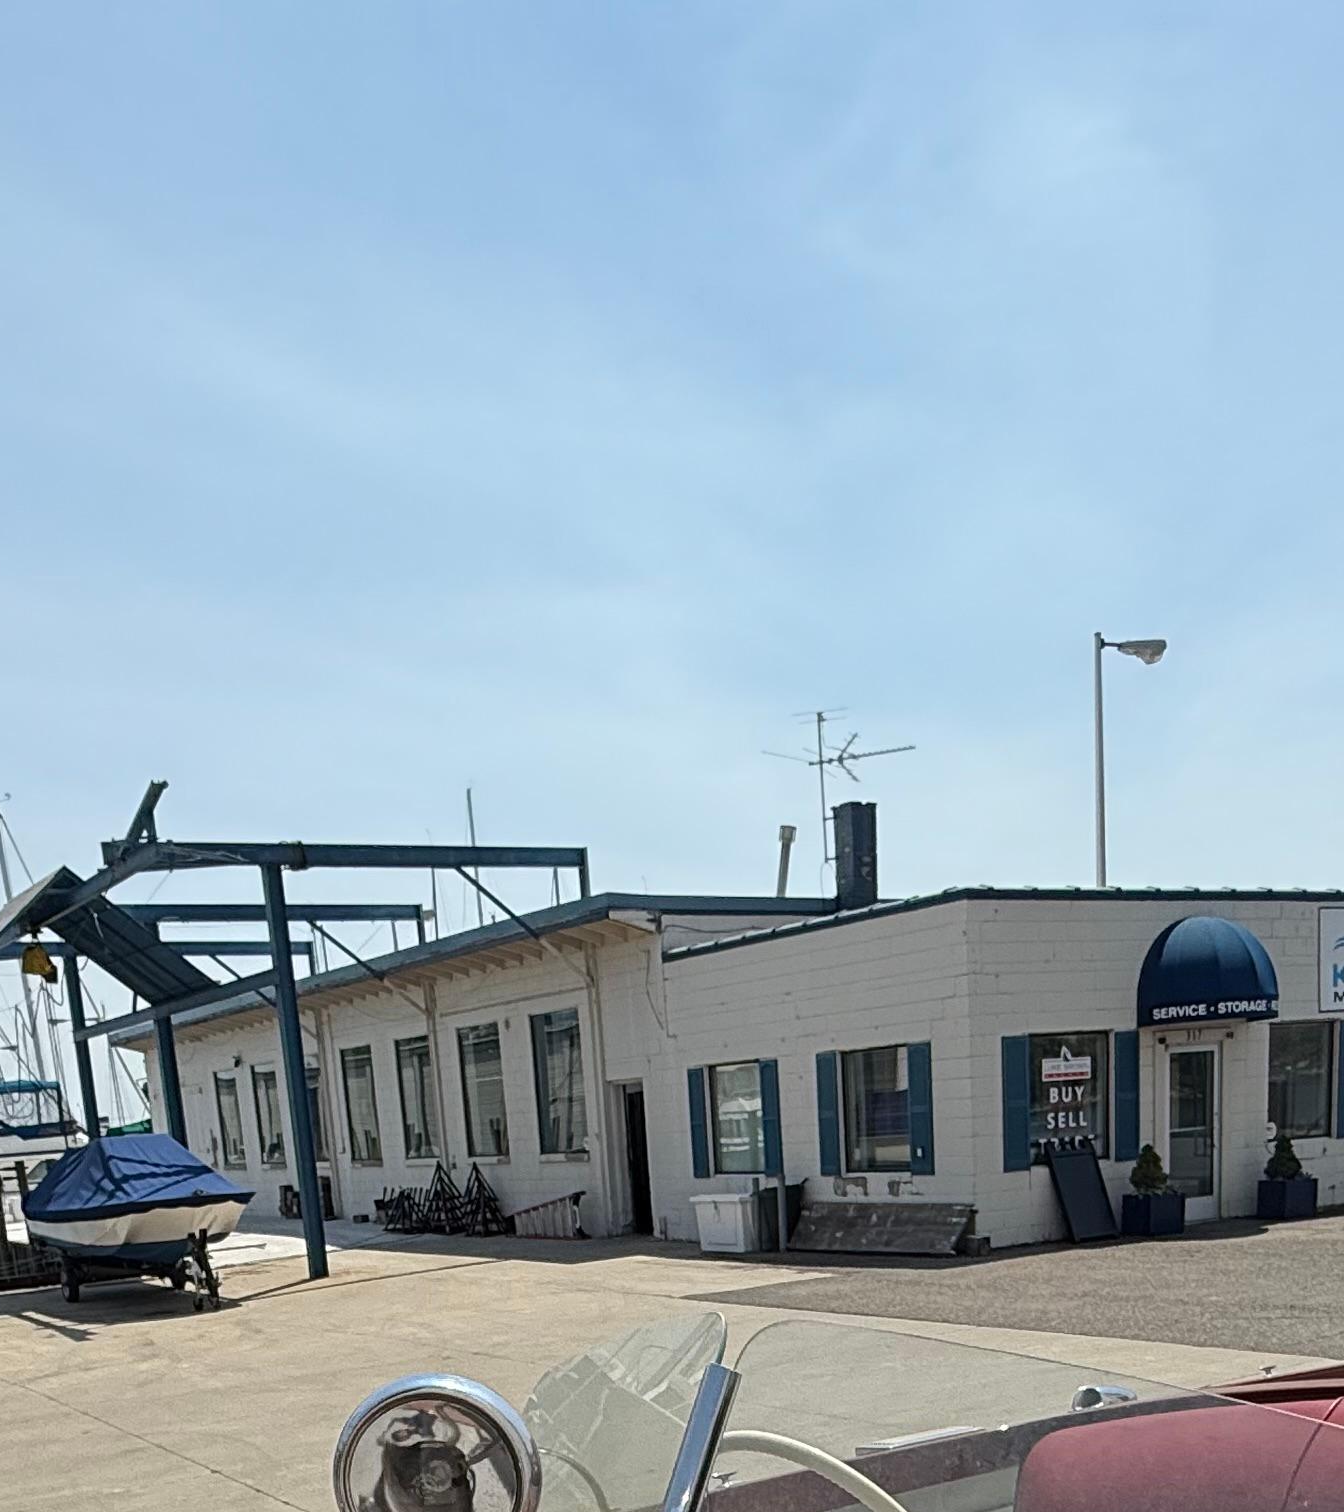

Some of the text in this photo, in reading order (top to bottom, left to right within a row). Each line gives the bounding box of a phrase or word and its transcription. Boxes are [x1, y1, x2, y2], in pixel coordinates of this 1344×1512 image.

[1152, 1003, 1208, 1020] SERVICE
[1217, 999, 1268, 1015] STORAGE
[1049, 1085, 1085, 1104] BUY
[1046, 1110, 1088, 1130] SELL
